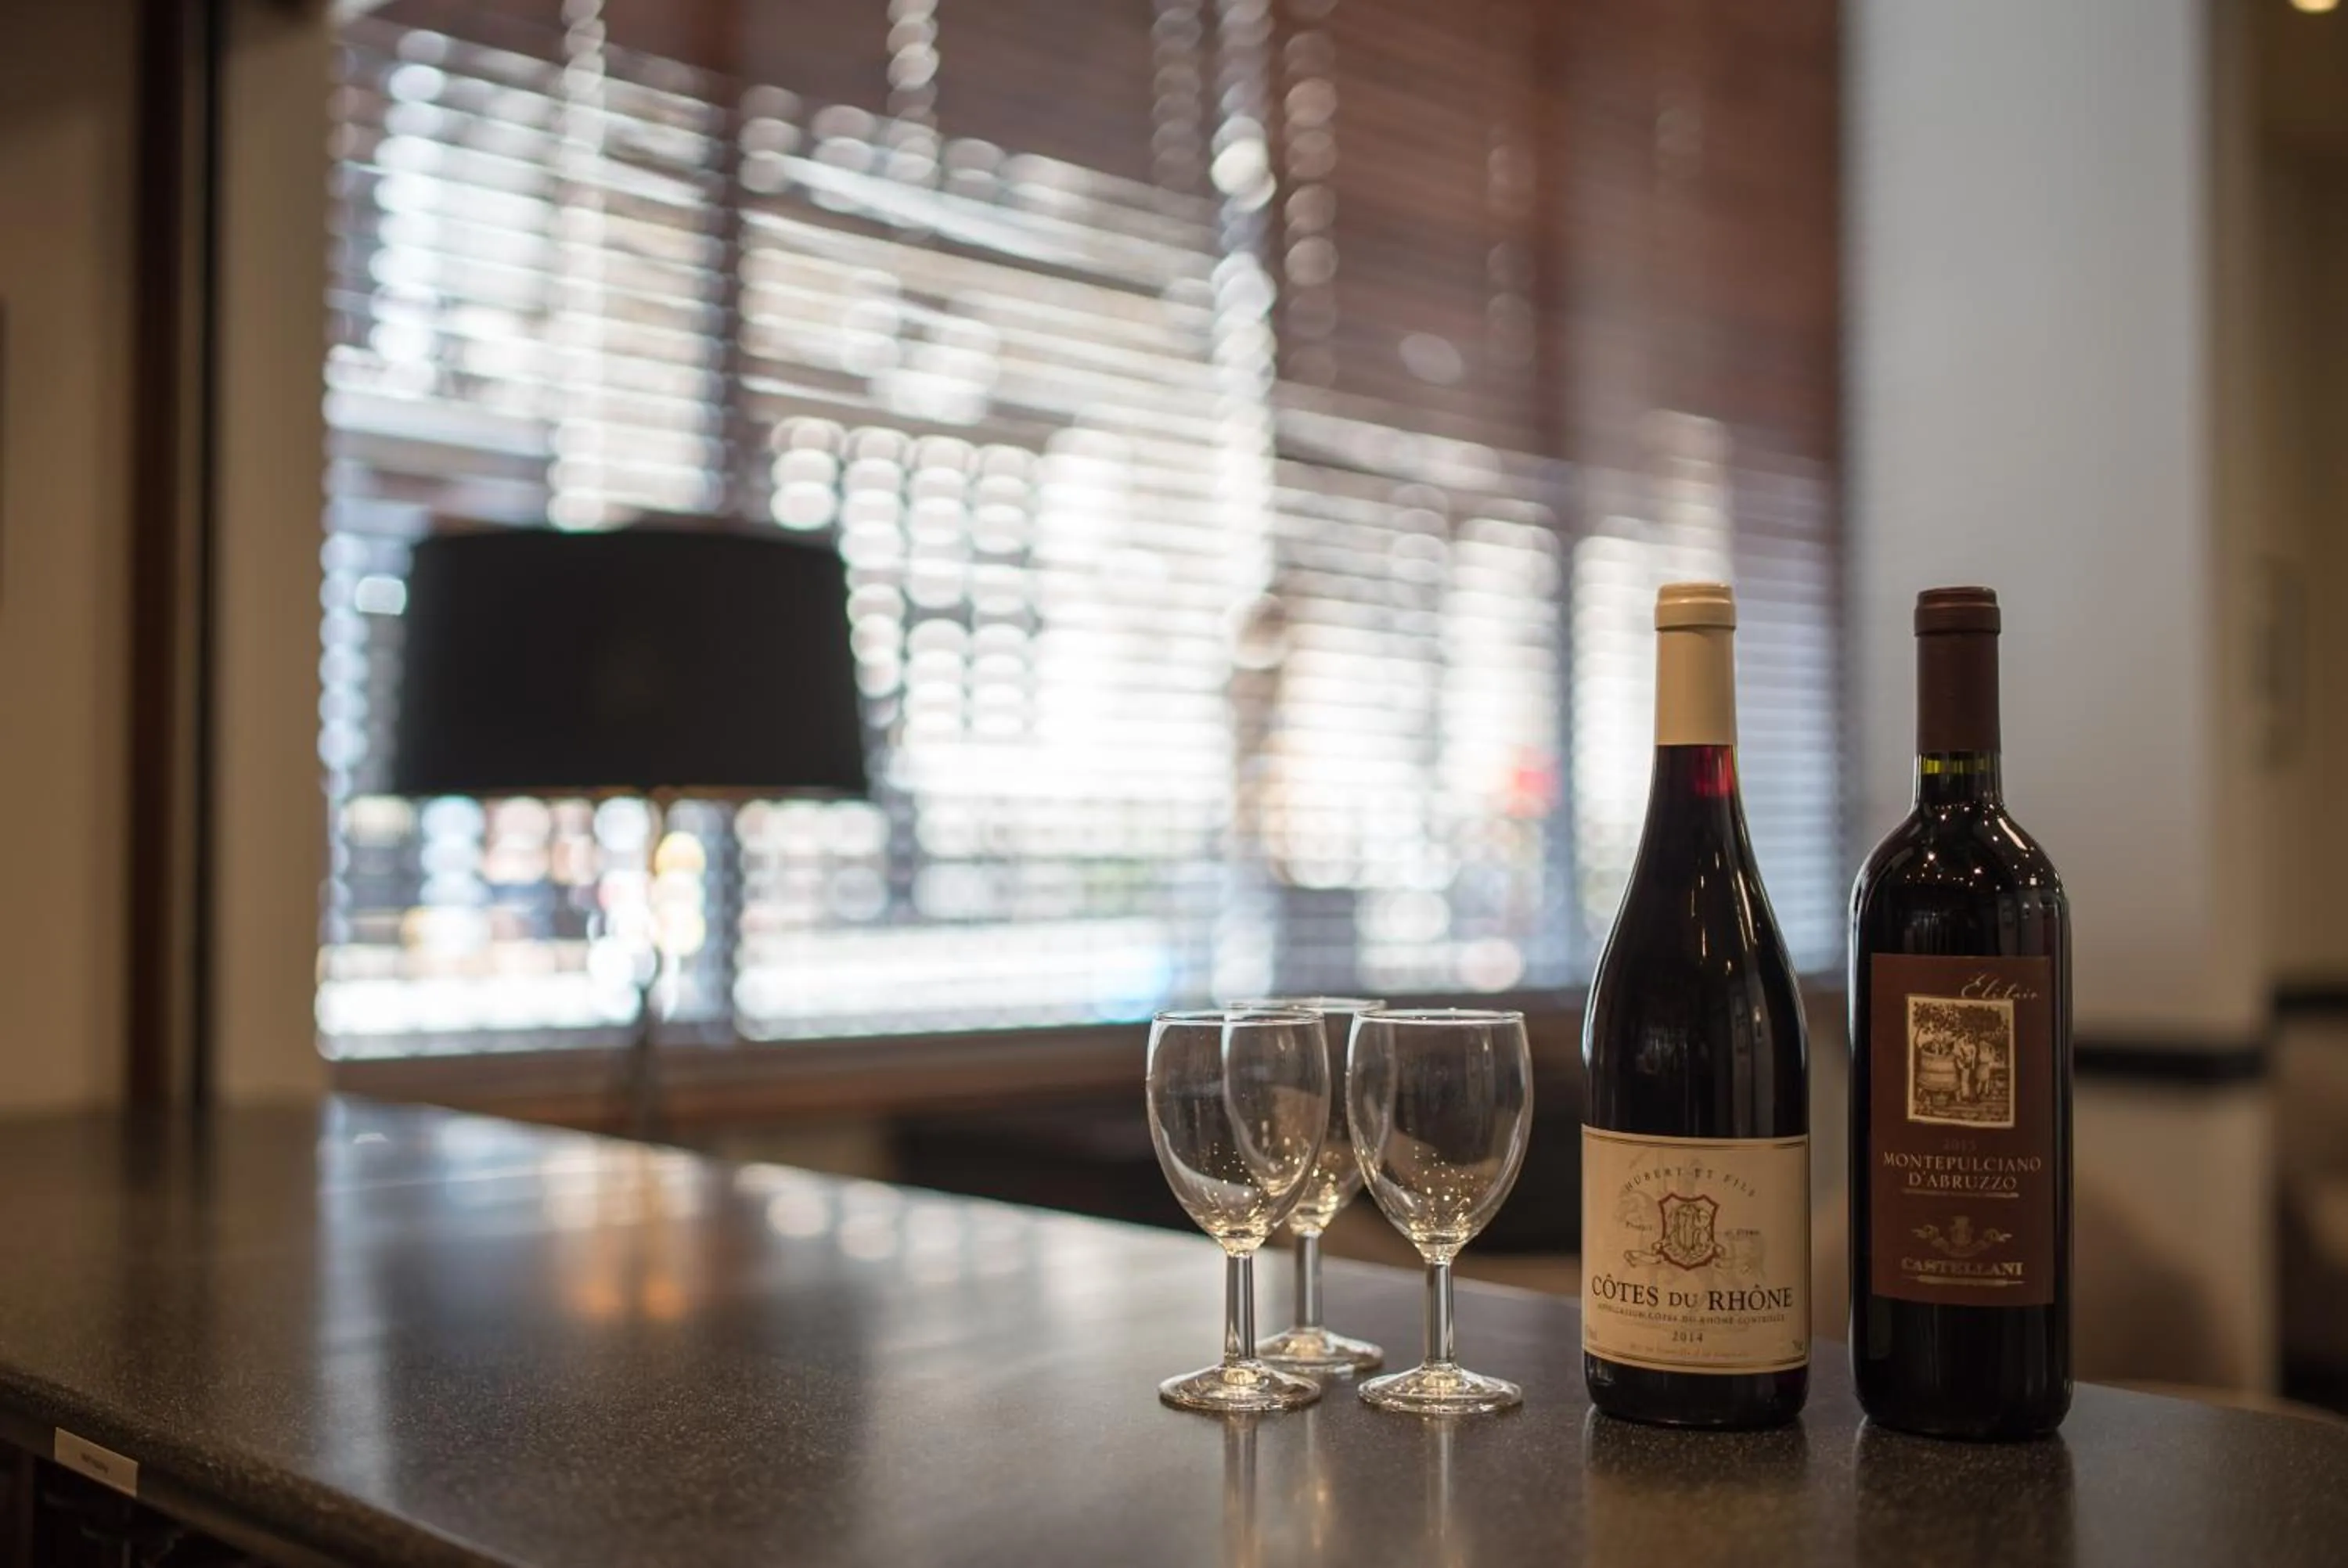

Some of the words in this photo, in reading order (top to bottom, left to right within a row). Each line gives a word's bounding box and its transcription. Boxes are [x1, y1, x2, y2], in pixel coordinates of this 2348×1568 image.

[1883, 1151, 2042, 1173] MONTEPULCIANO
[1626, 1167, 1682, 1192] HUBERT
[1694, 1167, 1714, 1178] ET
[1907, 1171, 2018, 1190] D'ABRUZZO
[1901, 1257, 2024, 1277] CASTELLANI
[1591, 1273, 1658, 1307] CÔTES
[1669, 1291, 1700, 1308] DU
[1709, 1284, 1793, 1311] RHÔNE
[1672, 1332, 1704, 1343] 2014
